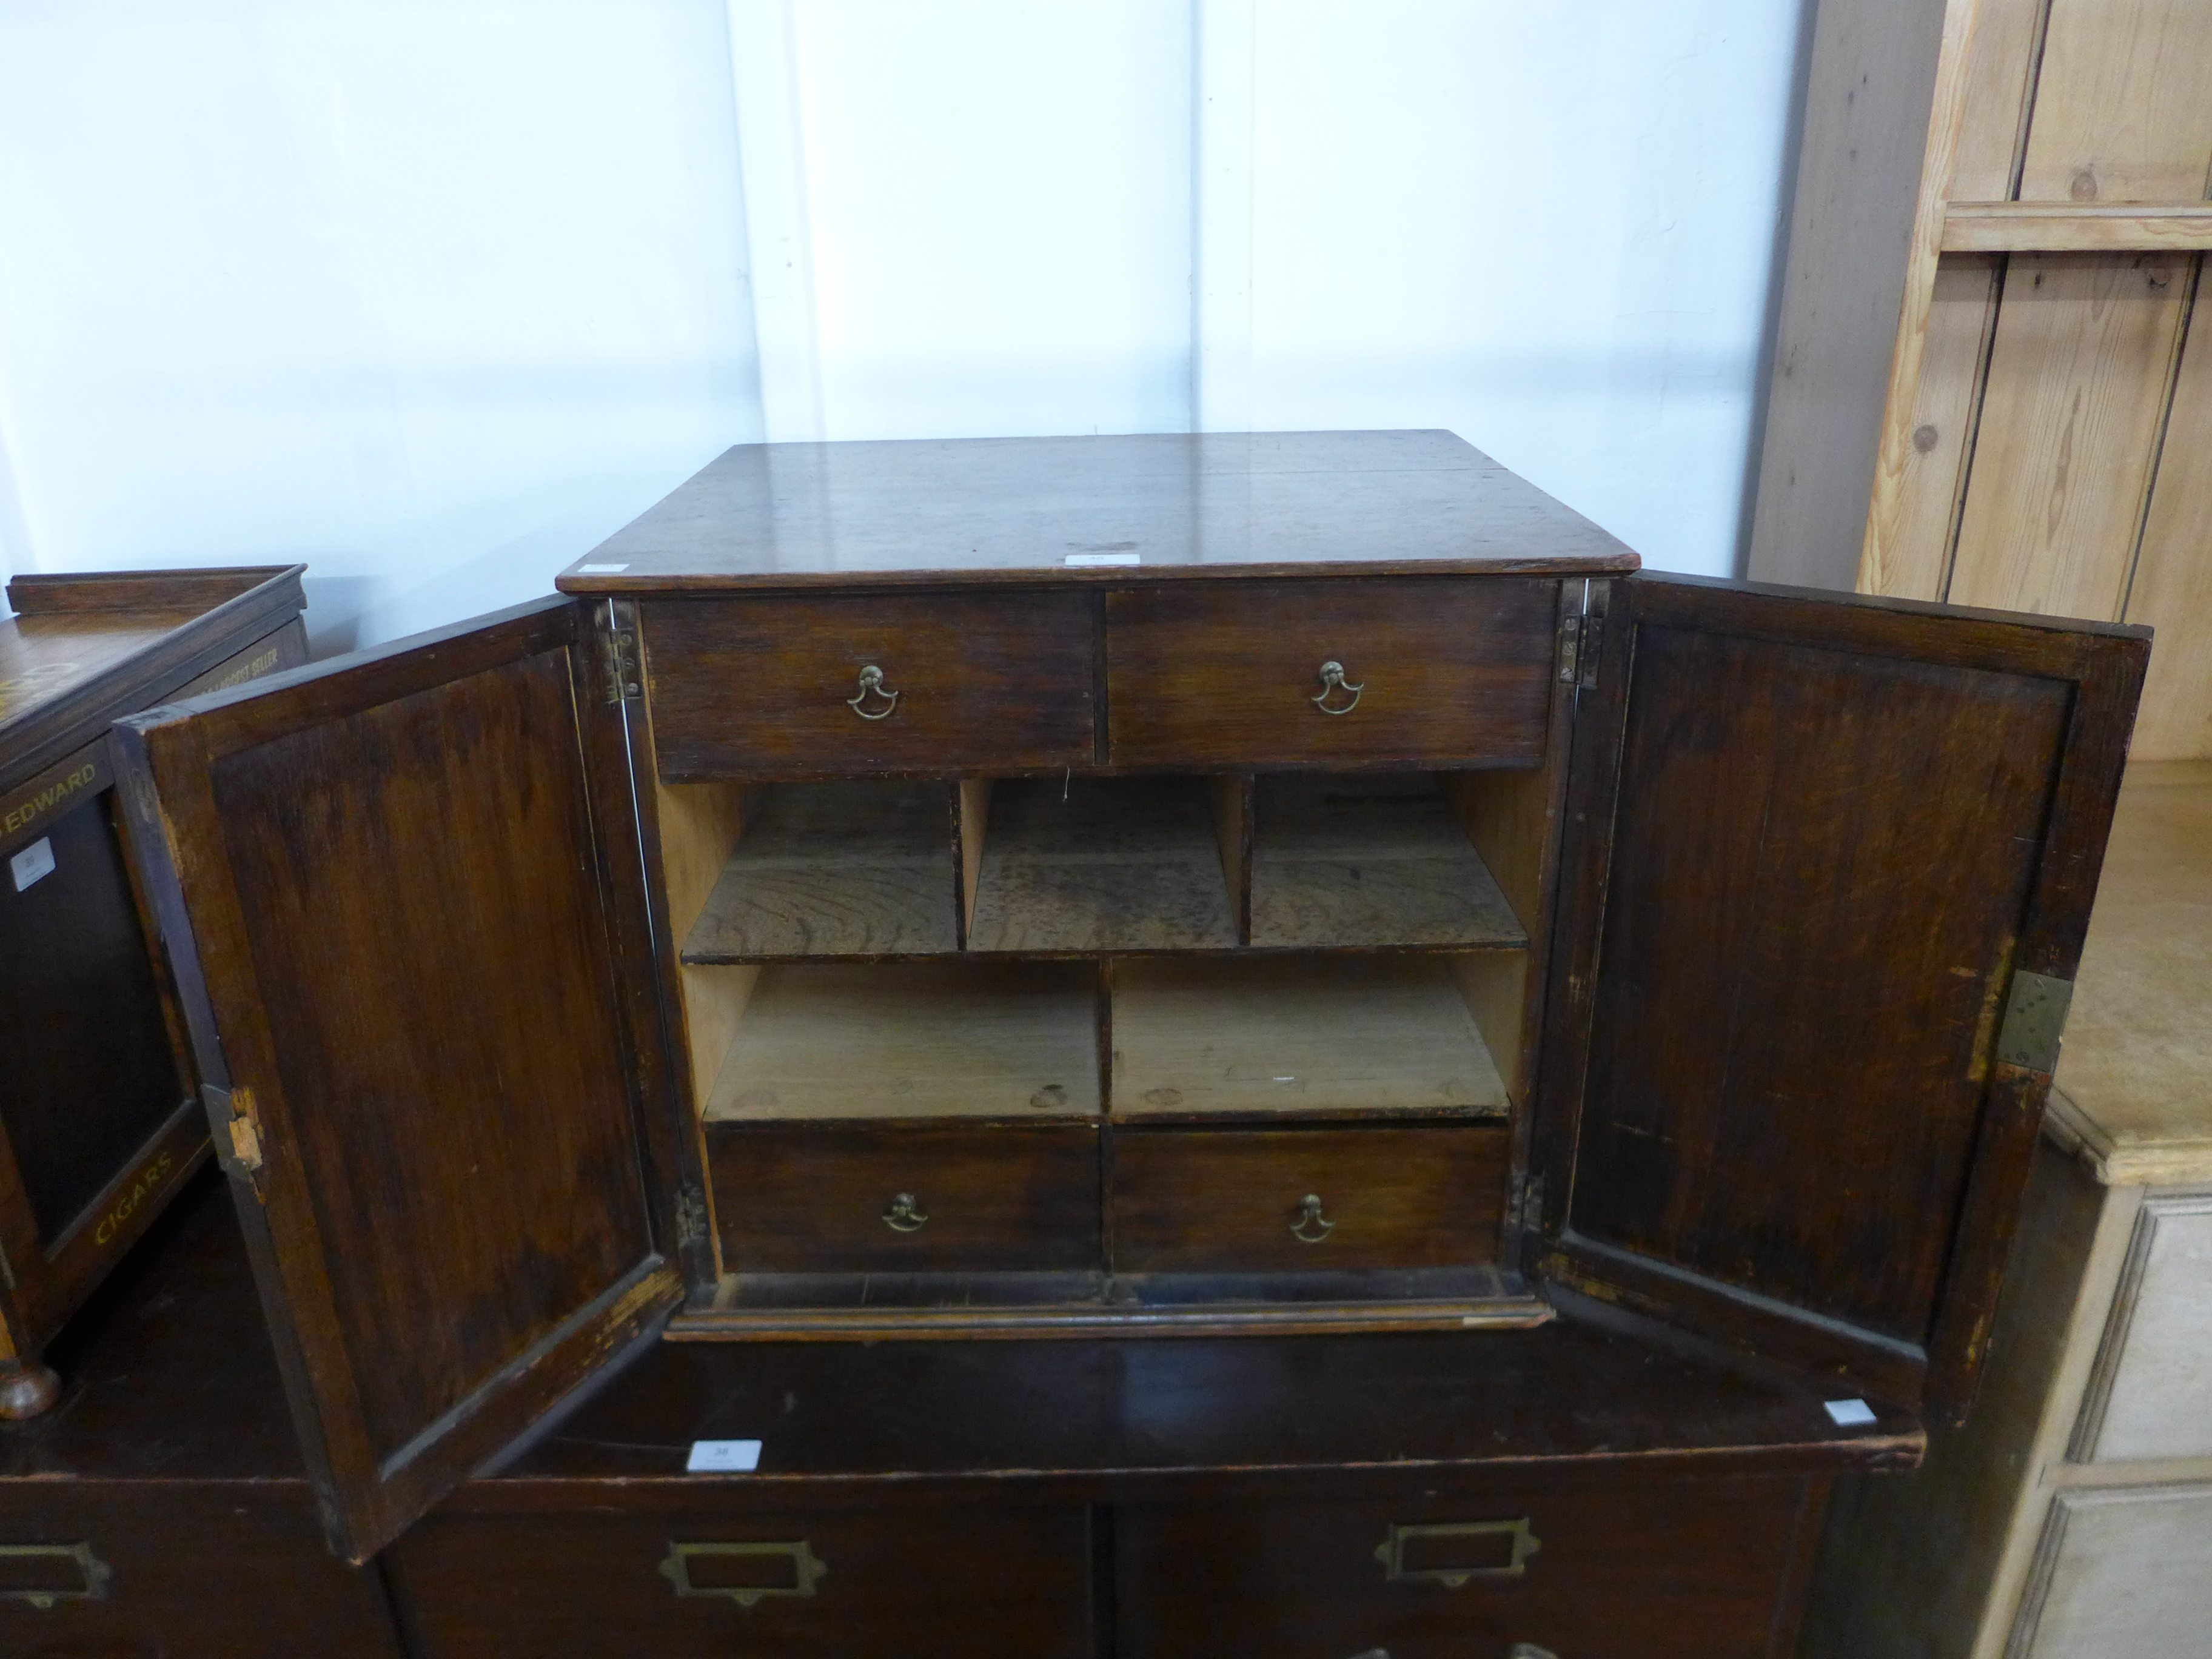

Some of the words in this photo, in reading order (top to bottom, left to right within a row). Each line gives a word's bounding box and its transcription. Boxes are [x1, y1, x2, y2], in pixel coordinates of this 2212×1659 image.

[252, 648, 278, 676] SELLER
[5, 763, 95, 833] EDWARD
[96, 1151, 172, 1244] CIGARS
